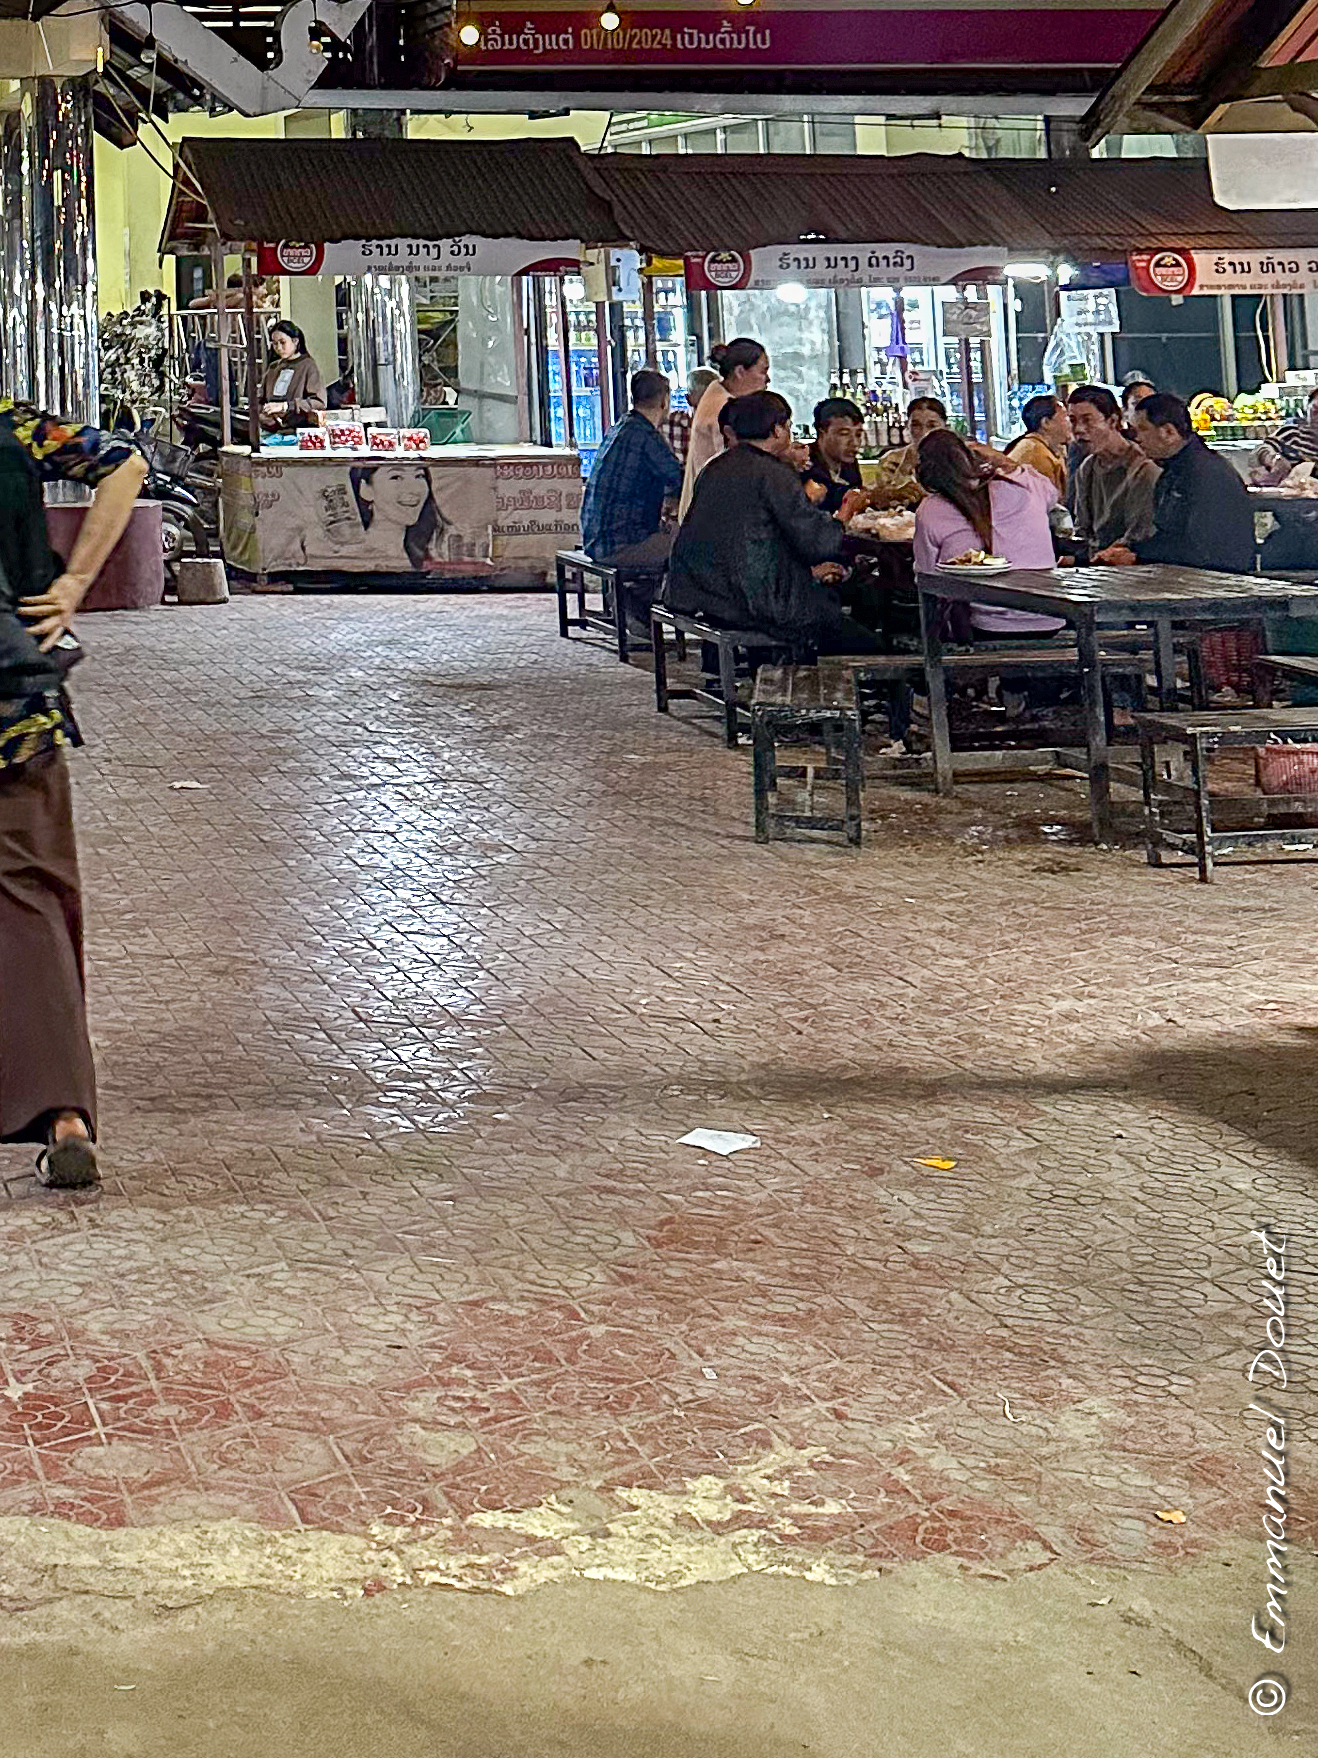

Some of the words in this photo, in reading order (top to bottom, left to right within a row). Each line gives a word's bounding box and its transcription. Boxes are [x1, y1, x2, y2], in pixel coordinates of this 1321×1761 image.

[580, 27, 673, 50] 01/10/2024
[406, 243, 442, 260] ນາງ
[778, 251, 817, 270] ຮ້ານ
[825, 256, 860, 273] ນາງ
[1213, 256, 1252, 274] ຮ້ານ
